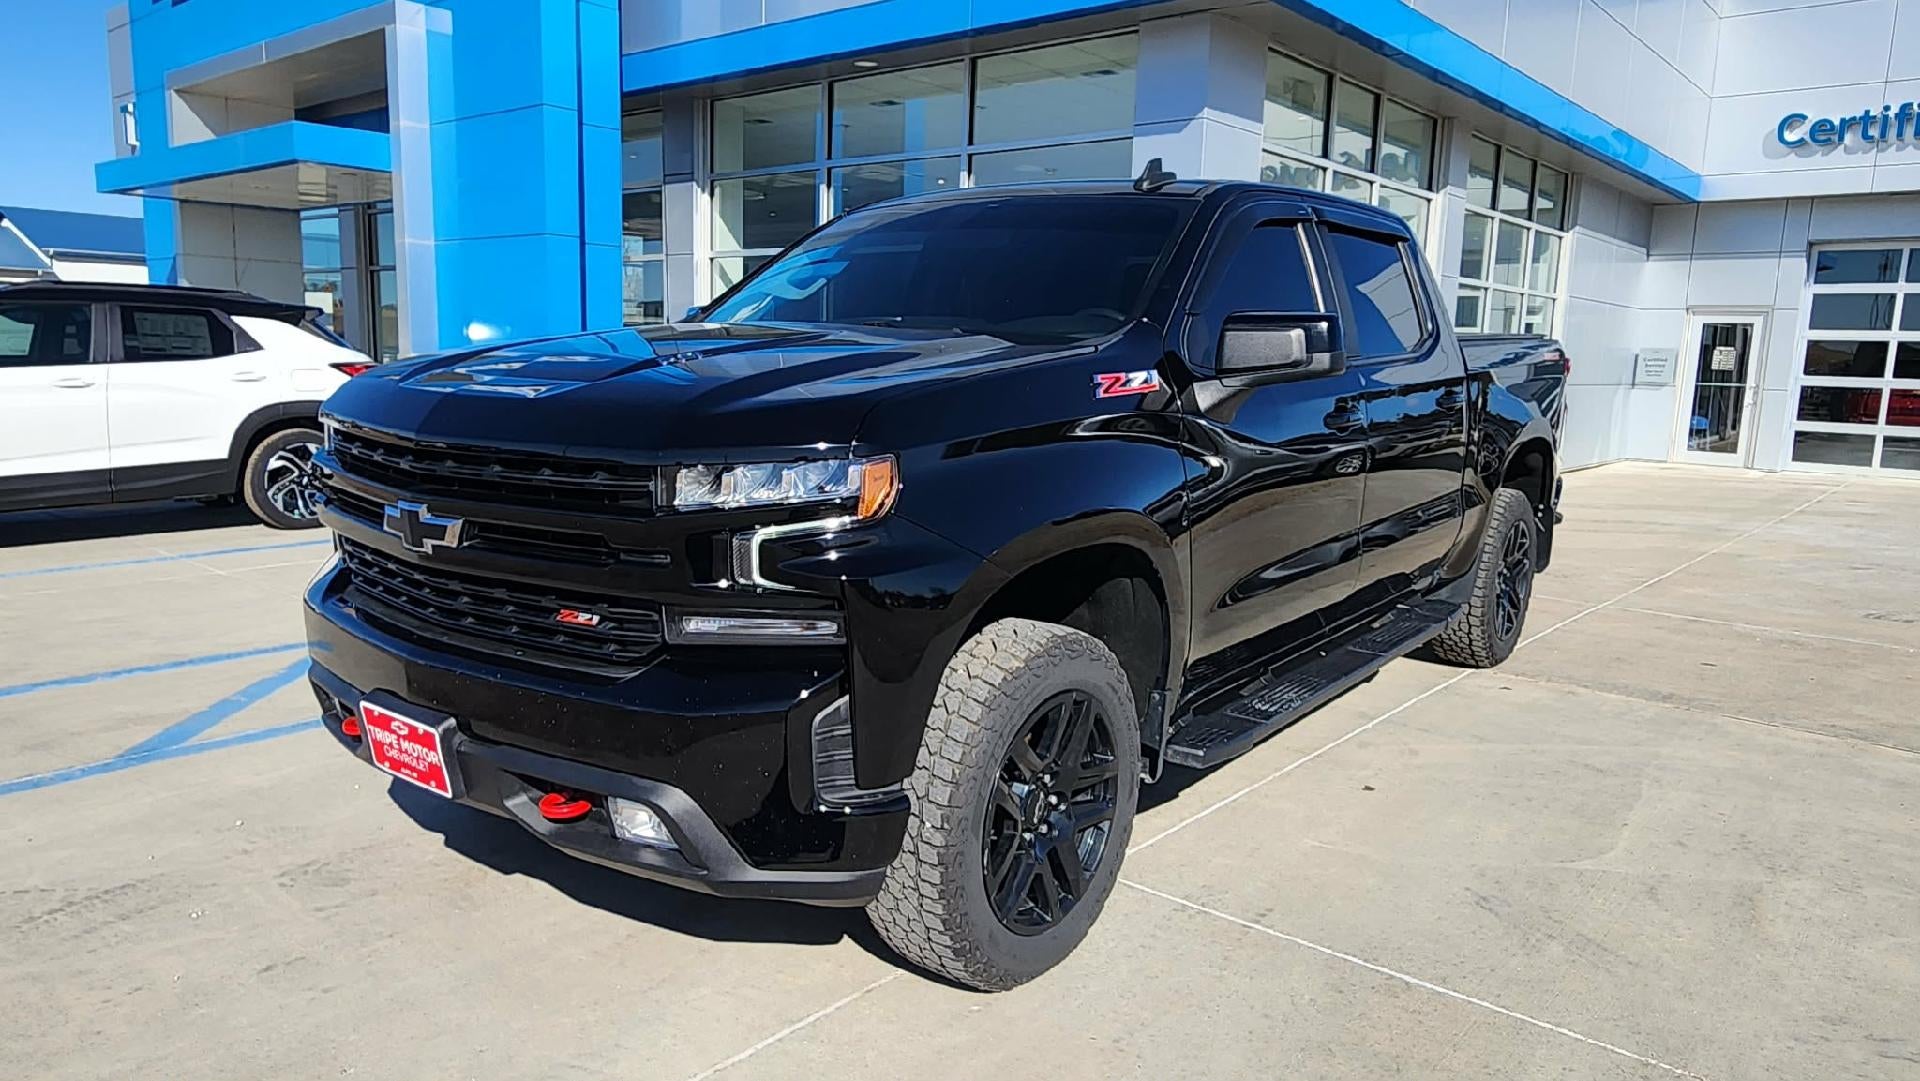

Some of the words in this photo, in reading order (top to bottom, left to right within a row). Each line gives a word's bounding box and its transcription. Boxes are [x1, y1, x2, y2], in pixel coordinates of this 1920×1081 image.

[1093, 369, 1159, 398] Z71
[556, 609, 600, 625] Z71
[368, 724, 399, 749] TRIPE
[399, 737, 440, 767] MOTOR
[383, 744, 429, 773] CHEVROLET
